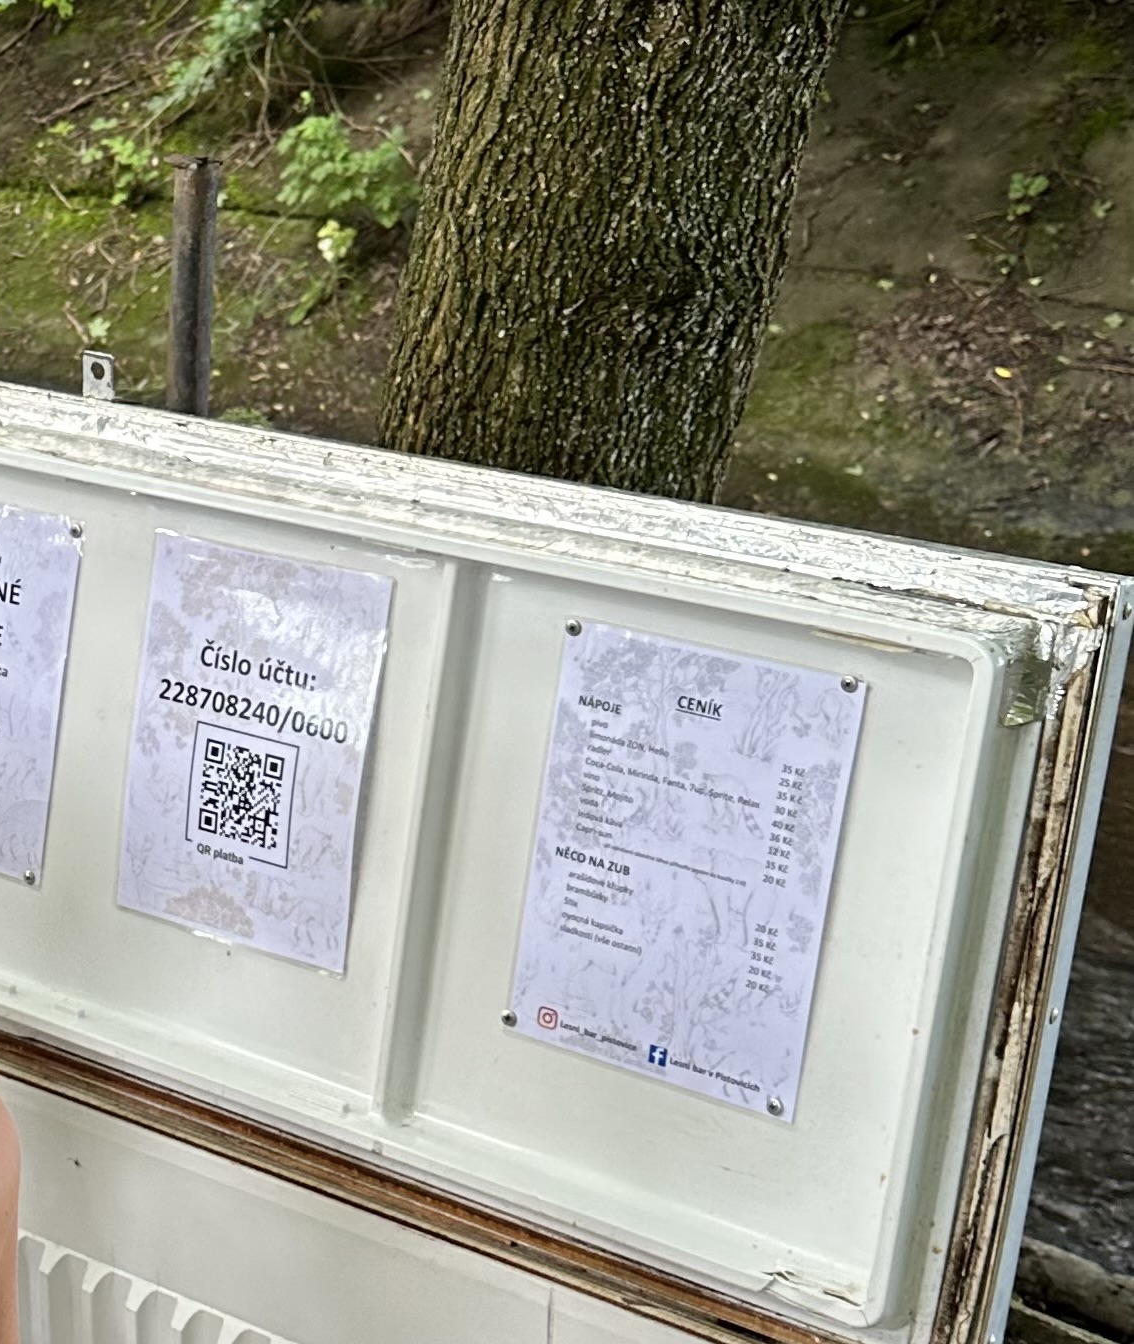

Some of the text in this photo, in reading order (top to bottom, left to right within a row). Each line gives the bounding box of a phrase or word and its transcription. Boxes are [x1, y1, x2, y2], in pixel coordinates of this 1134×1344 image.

[201, 638, 316, 691] Číslo účtu:
[159, 678, 348, 744] 228708240/0600
[578, 693, 623, 716] NÁPOJE
[677, 694, 723, 717] CENÍK
[648, 745, 669, 756] Hello
[584, 758, 626, 774] Coca-Cola,
[662, 777, 688, 790] Fanta,
[781, 763, 805, 777] 35 Kč
[778, 777, 803, 790] 25 Kč
[579, 797, 598, 806] voda
[776, 790, 788, 801] 35
[774, 804, 798, 818] 30 Kč
[771, 819, 795, 832] 40 Kč
[769, 832, 793, 846] 36 Kč
[196, 842, 244, 865] QR platba
[555, 843, 586, 862] NĚCO
[588, 856, 605, 868] NA
[607, 860, 630, 875] ZUB
[779, 848, 791, 859] Kč
[777, 862, 789, 873] Kč
[762, 873, 786, 888] 20 Kč
[754, 923, 778, 937] 20 Kč
[753, 936, 776, 951] 35 Kč
[750, 950, 774, 965] 35 Kč
[748, 965, 771, 979] 20 Kč
[745, 979, 769, 993] 20 Kč
